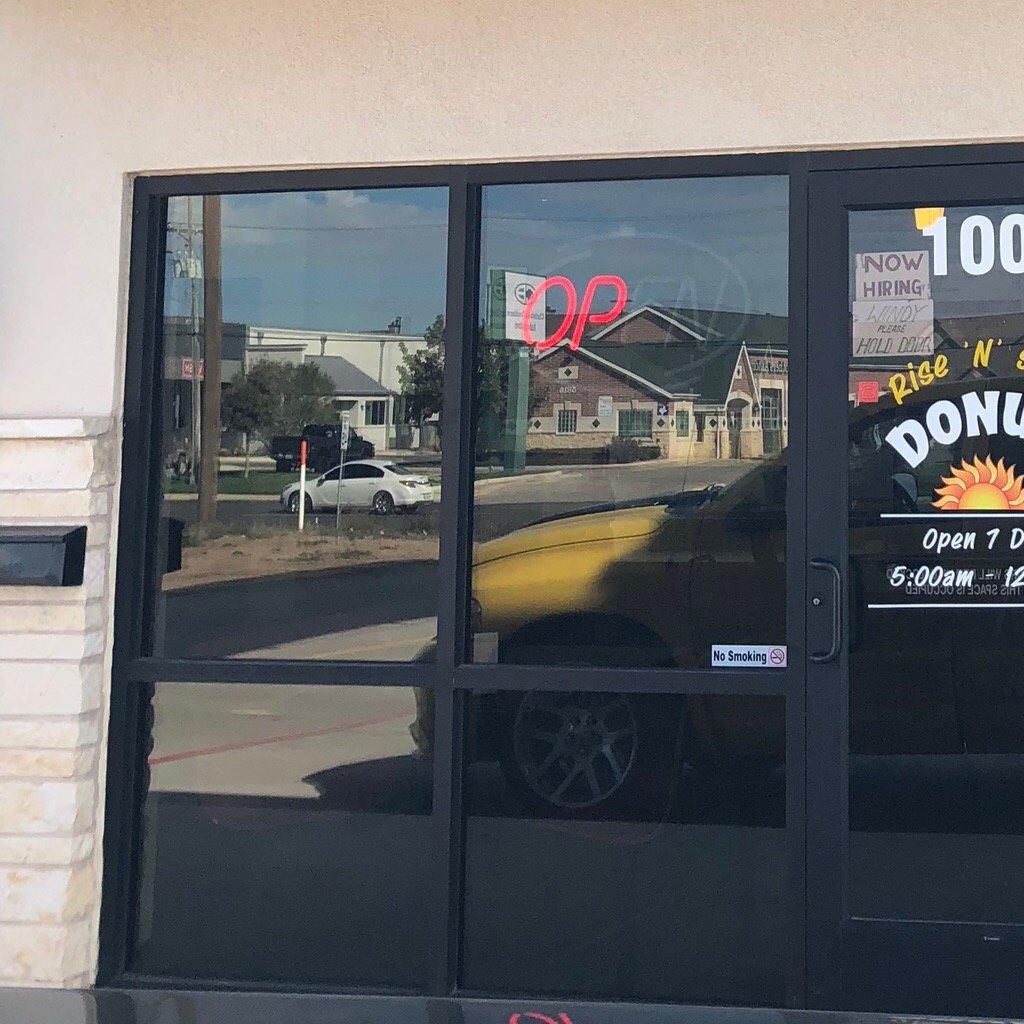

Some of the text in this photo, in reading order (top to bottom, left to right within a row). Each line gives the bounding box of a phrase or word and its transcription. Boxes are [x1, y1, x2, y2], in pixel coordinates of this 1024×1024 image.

[863, 253, 924, 274] NOW
[863, 278, 924, 297] HIRING
[877, 324, 907, 334] PLEASE
[856, 335, 932, 354] HOLD DOOR
[888, 354, 949, 405] Rise
[963, 338, 1003, 368] 'N'
[922, 528, 976, 553] Open
[986, 528, 1001, 550] 7
[889, 565, 974, 587] 5:00am
[713, 650, 767, 665] No Smoking
